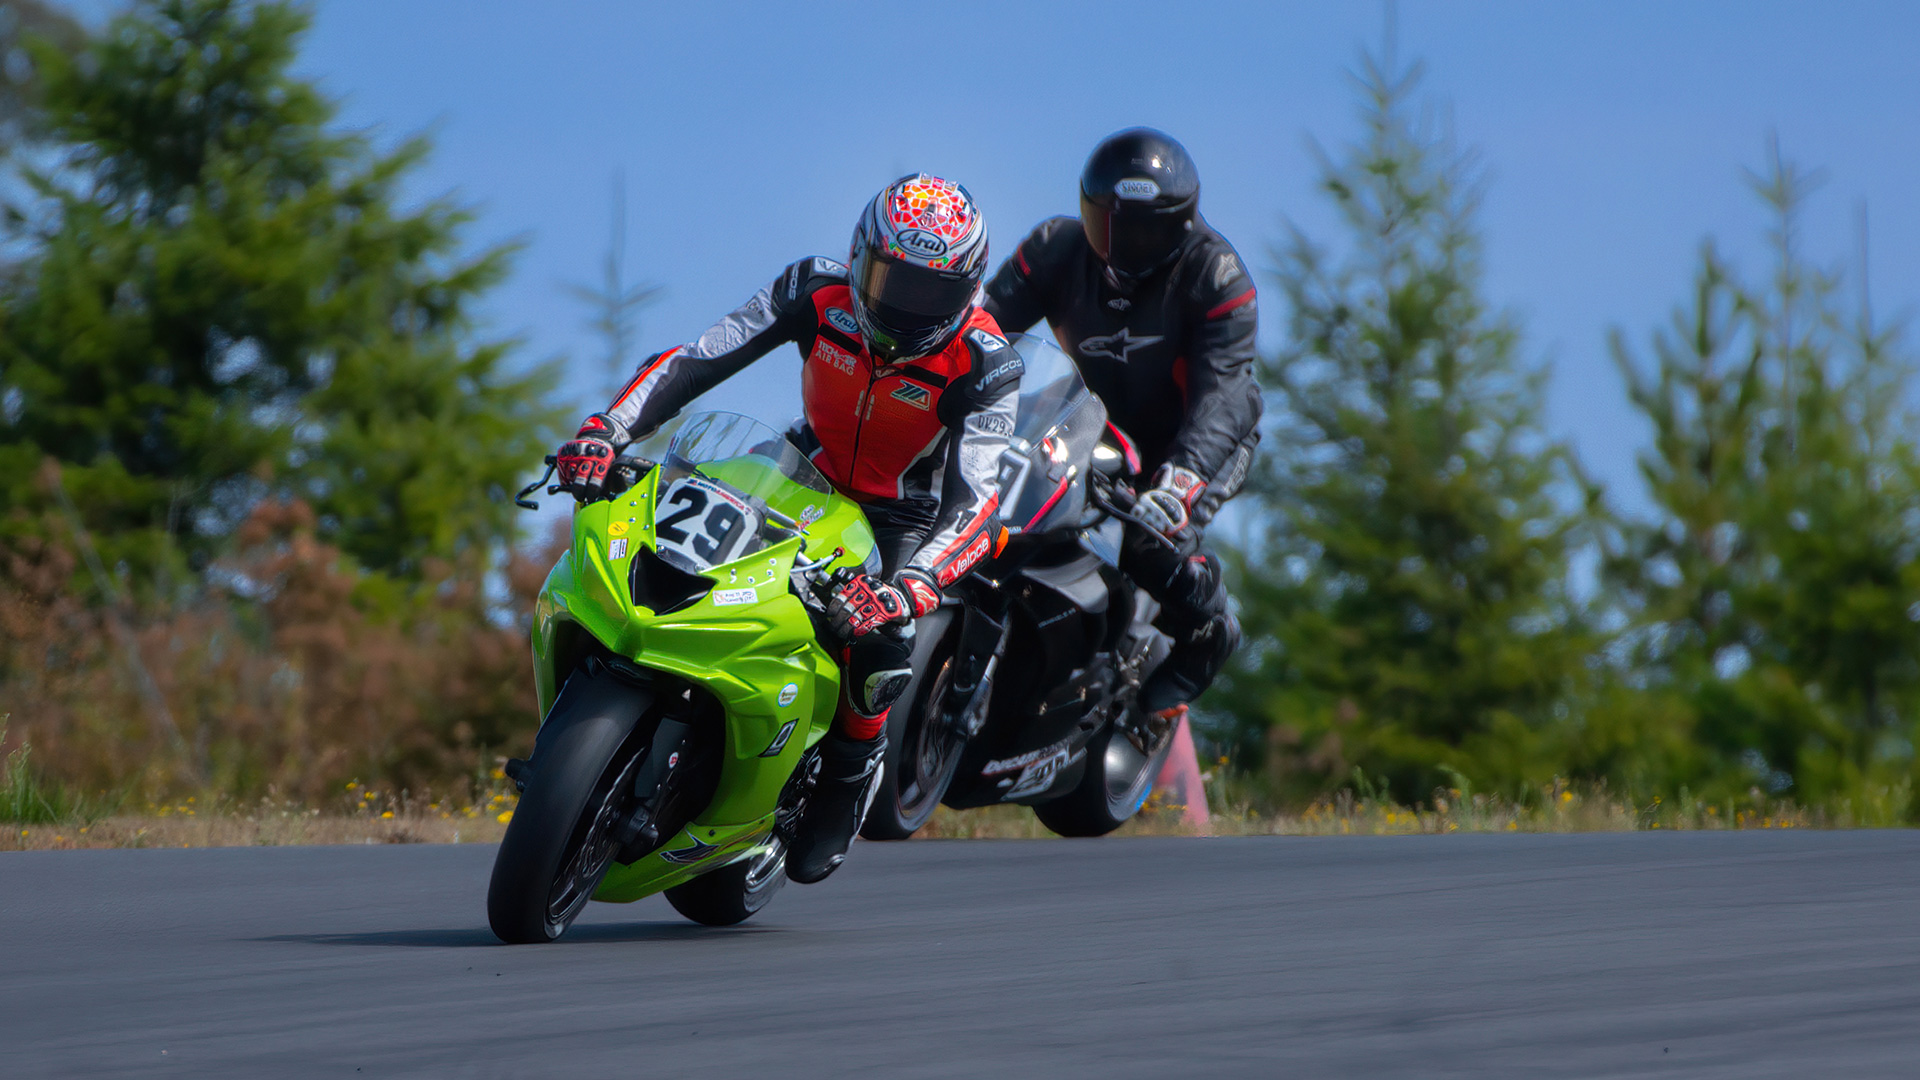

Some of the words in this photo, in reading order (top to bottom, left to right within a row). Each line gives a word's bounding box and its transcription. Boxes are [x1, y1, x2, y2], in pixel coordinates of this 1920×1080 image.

[899, 231, 941, 252] Arai
[828, 311, 857, 330] Arai
[655, 485, 746, 570] 29
